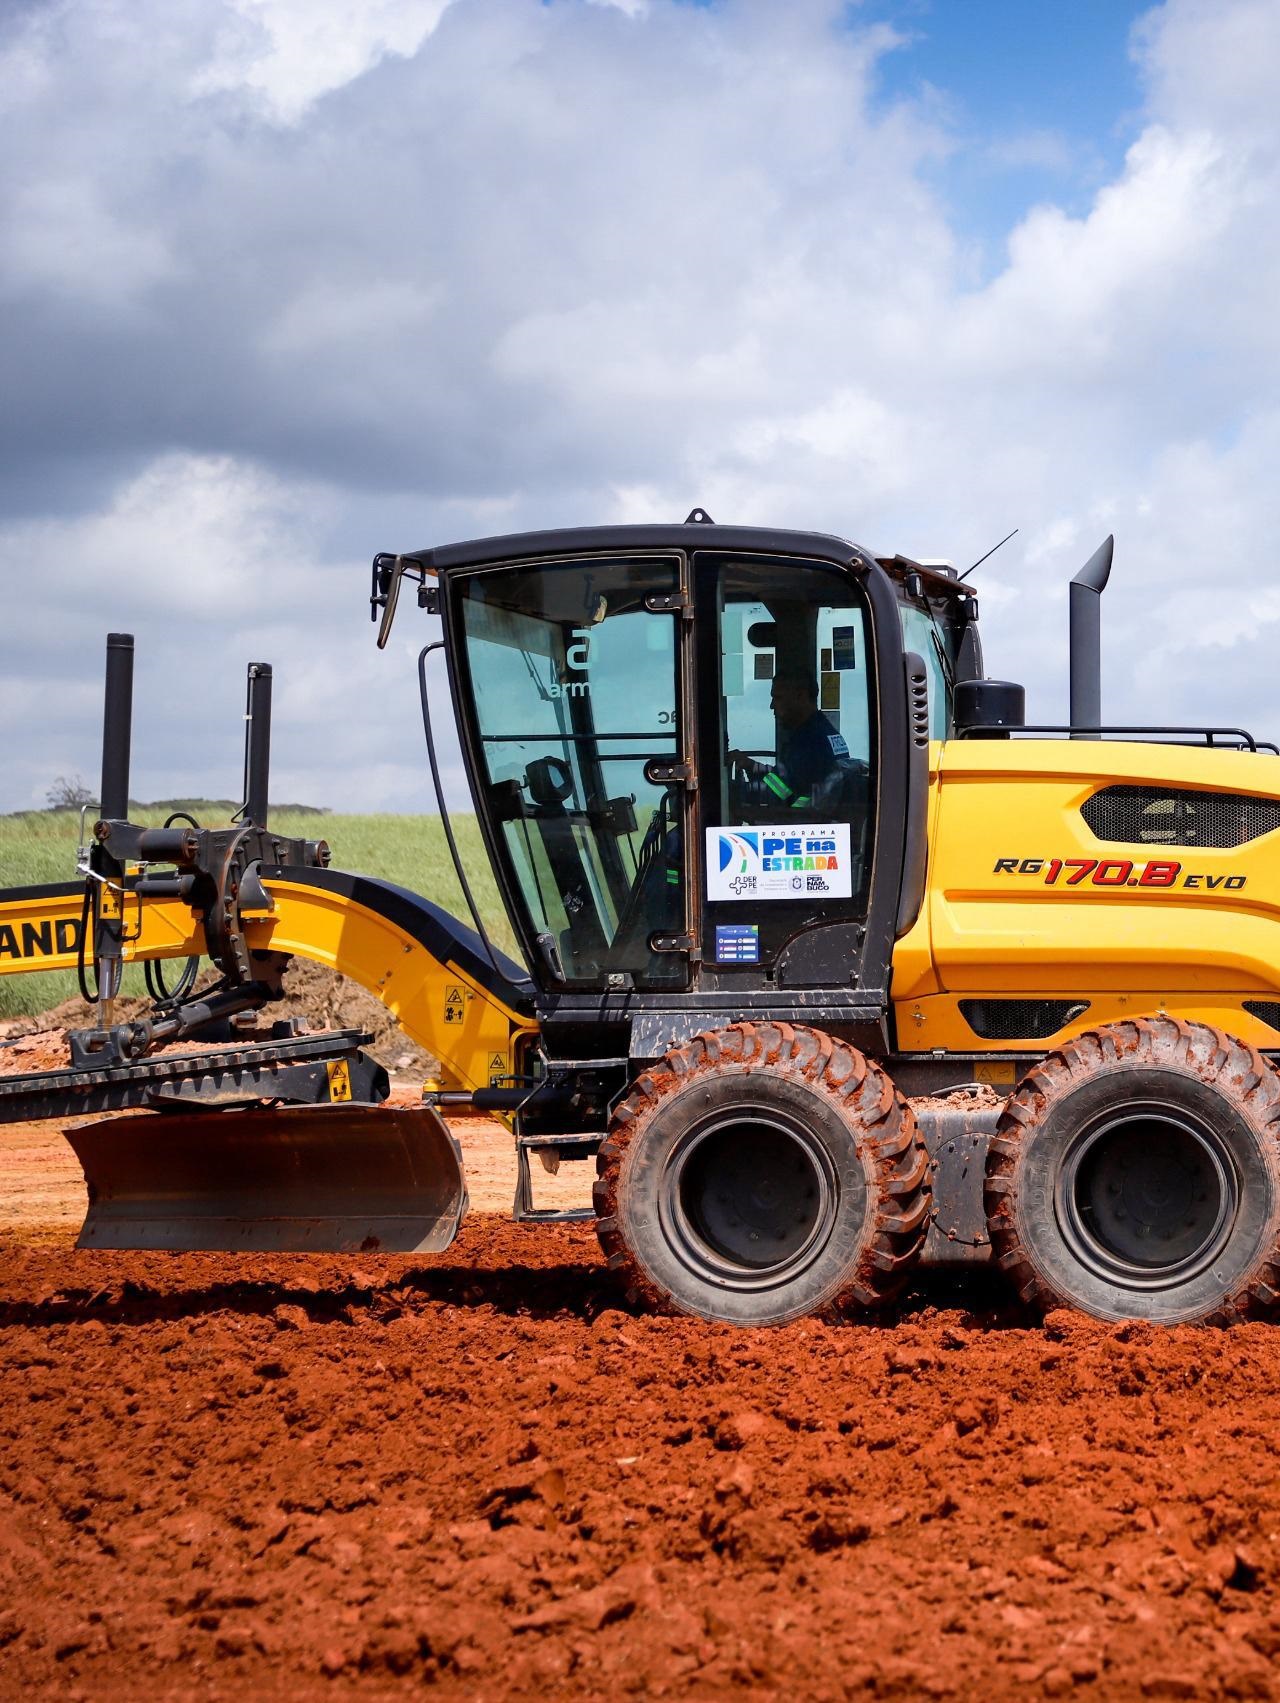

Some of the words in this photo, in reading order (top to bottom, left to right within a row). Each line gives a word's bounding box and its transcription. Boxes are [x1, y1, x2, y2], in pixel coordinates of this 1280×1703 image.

[762, 829, 836, 837] PROGRAMA
[763, 838, 802, 856] PE
[806, 840, 836, 852] na
[762, 855, 838, 871] ESTRADA
[993, 858, 1045, 874] RG
[1044, 858, 1182, 888] 170.B
[1183, 875, 1248, 890] EVO
